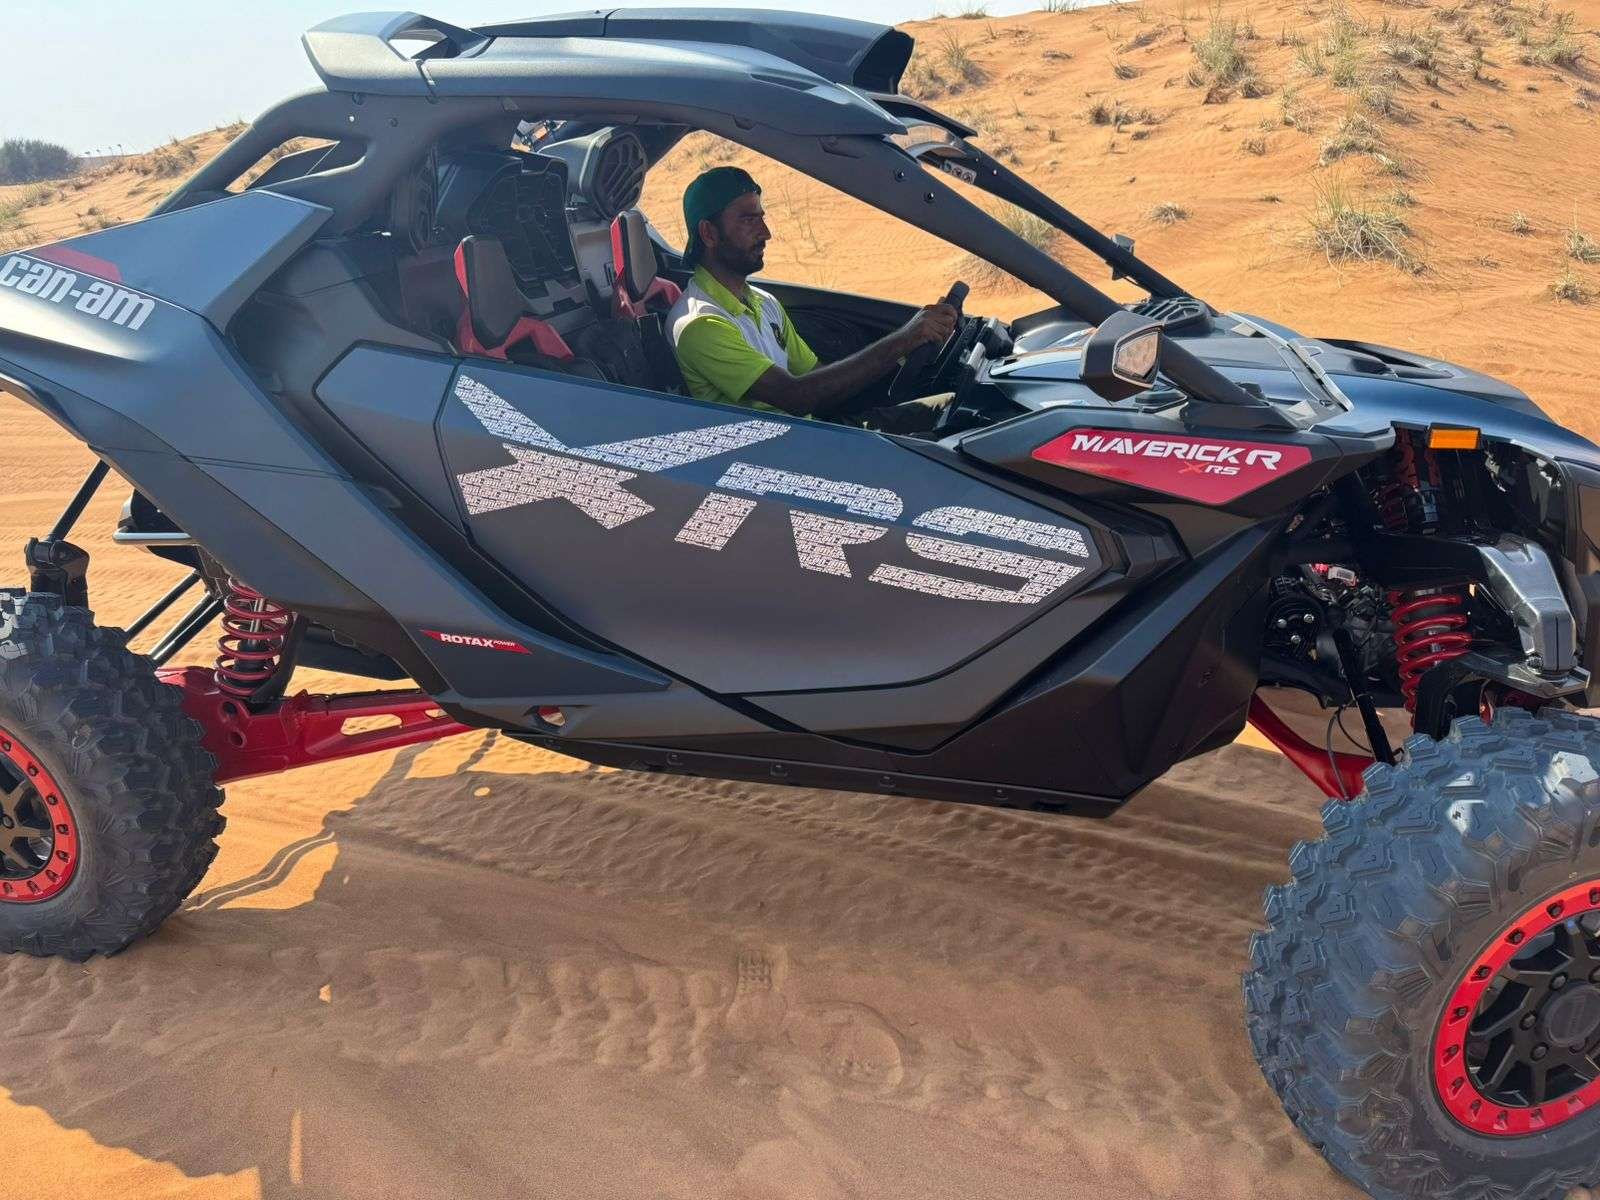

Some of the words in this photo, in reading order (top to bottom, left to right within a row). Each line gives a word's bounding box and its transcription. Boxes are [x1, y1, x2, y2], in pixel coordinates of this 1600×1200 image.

[0, 255, 155, 331] can-am
[1071, 434, 1247, 464] MAVERICK
[1245, 449, 1282, 471] R
[1178, 461, 1240, 475] XRS
[454, 374, 1090, 605] XRS
[440, 633, 495, 648] ROTAX
